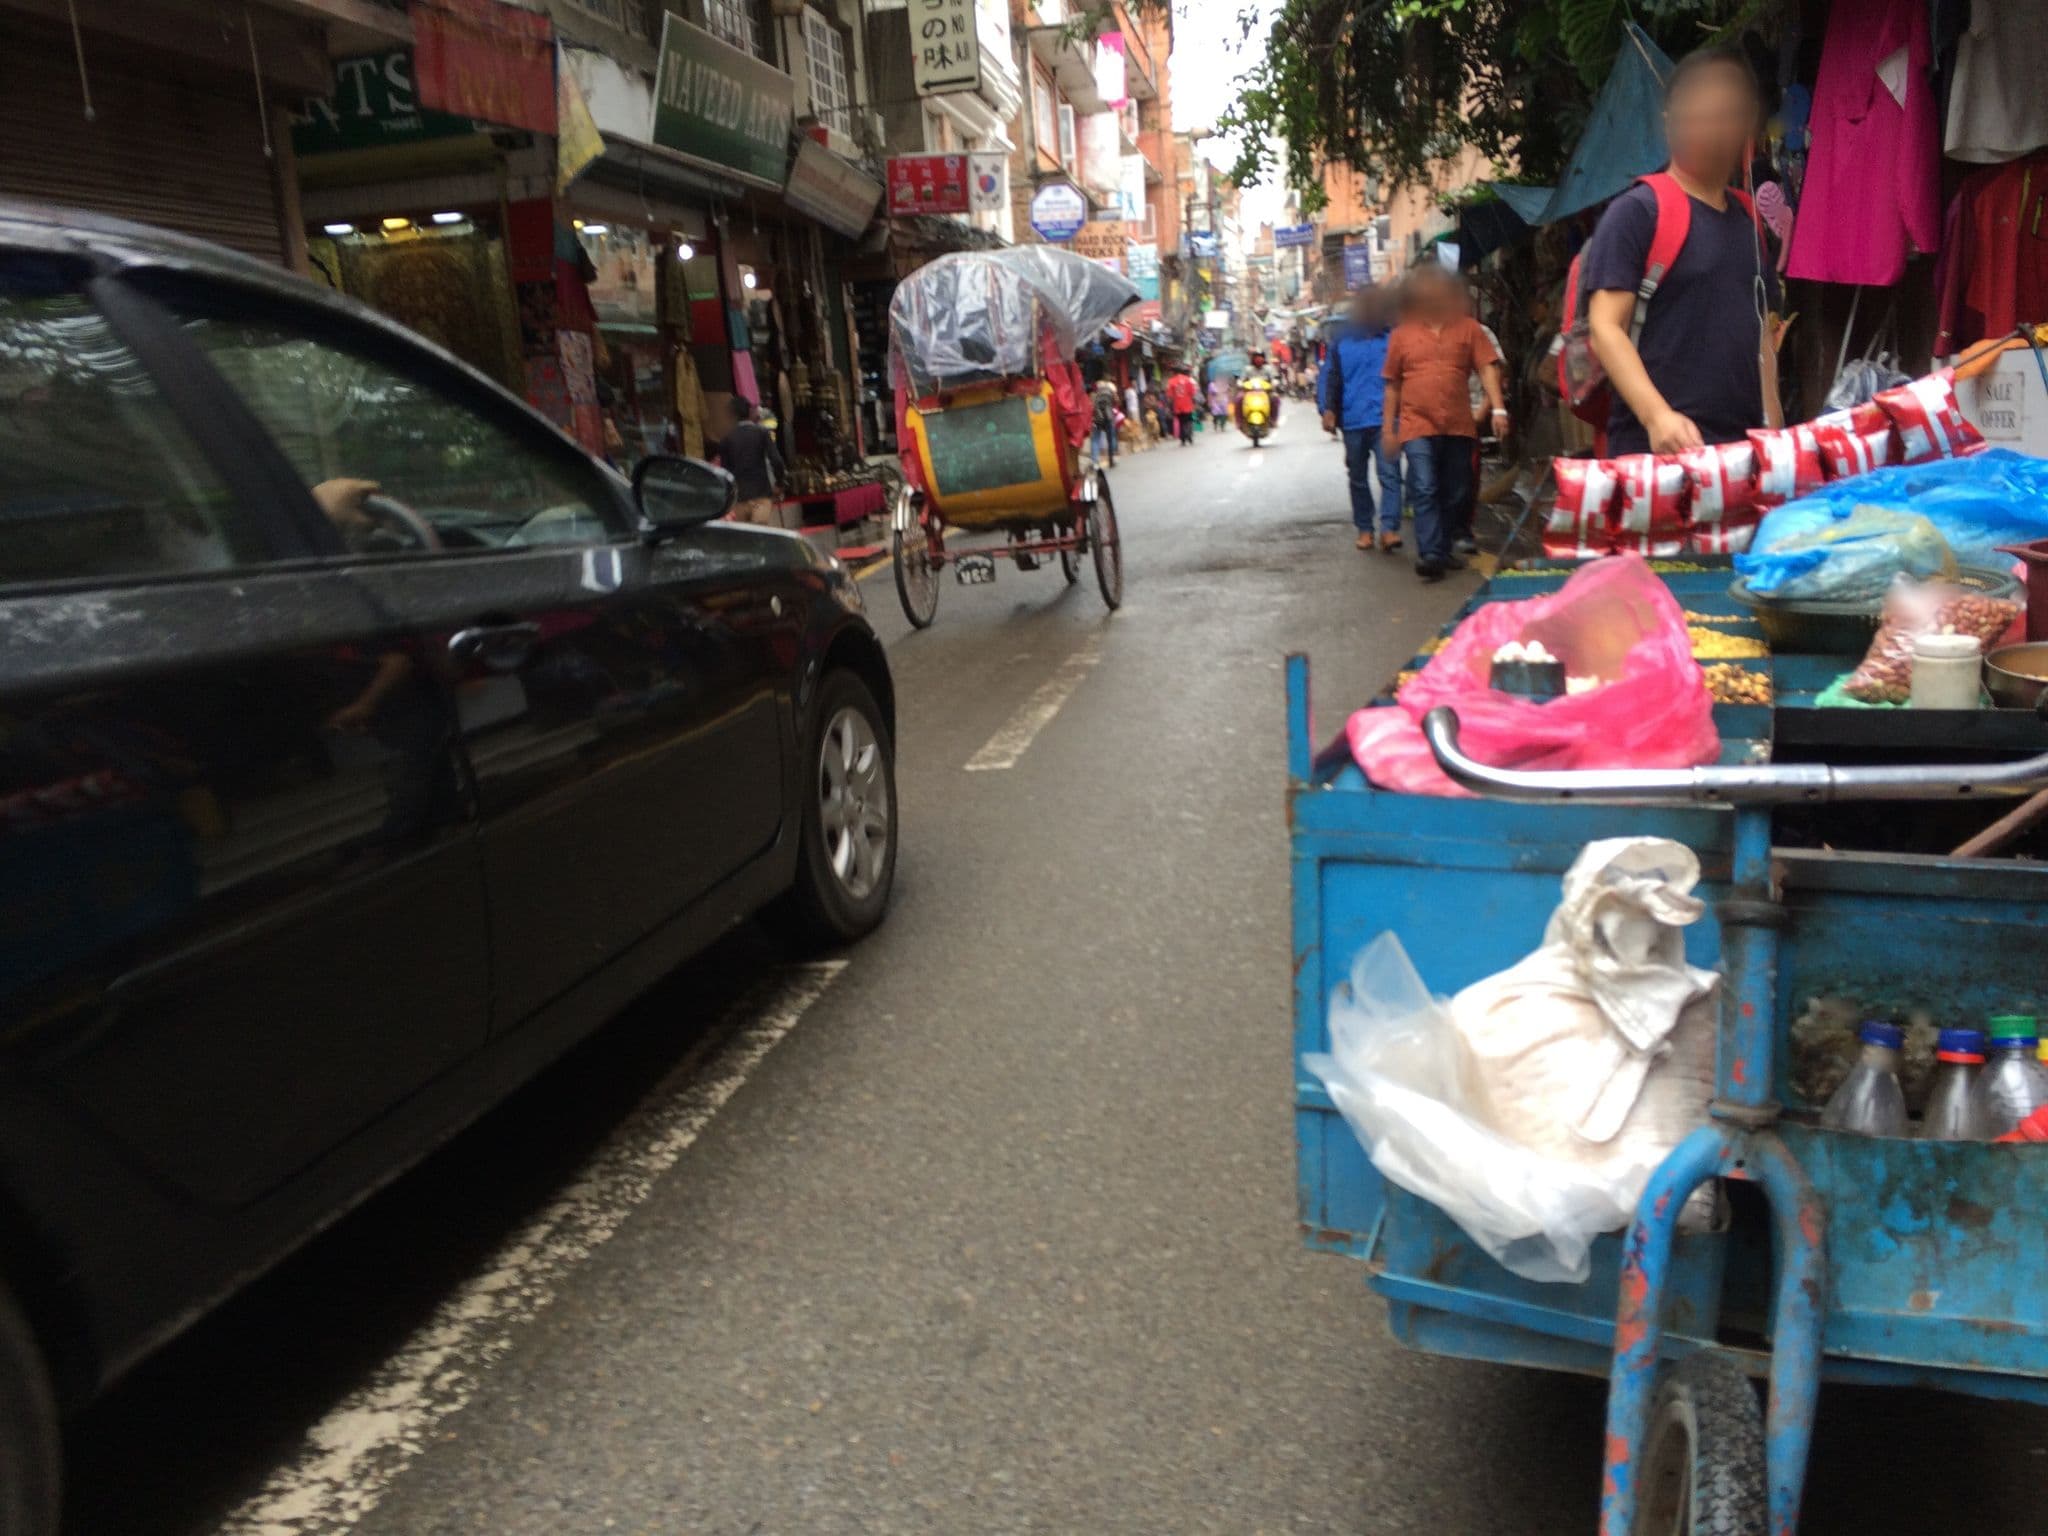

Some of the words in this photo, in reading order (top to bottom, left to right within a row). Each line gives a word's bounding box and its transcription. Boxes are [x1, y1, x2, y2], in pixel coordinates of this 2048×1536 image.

[662, 50, 742, 130] NAVEED
[744, 87, 789, 149] ARTS
[1985, 383, 2013, 400] SALE
[1981, 410, 2016, 429] OFFER
